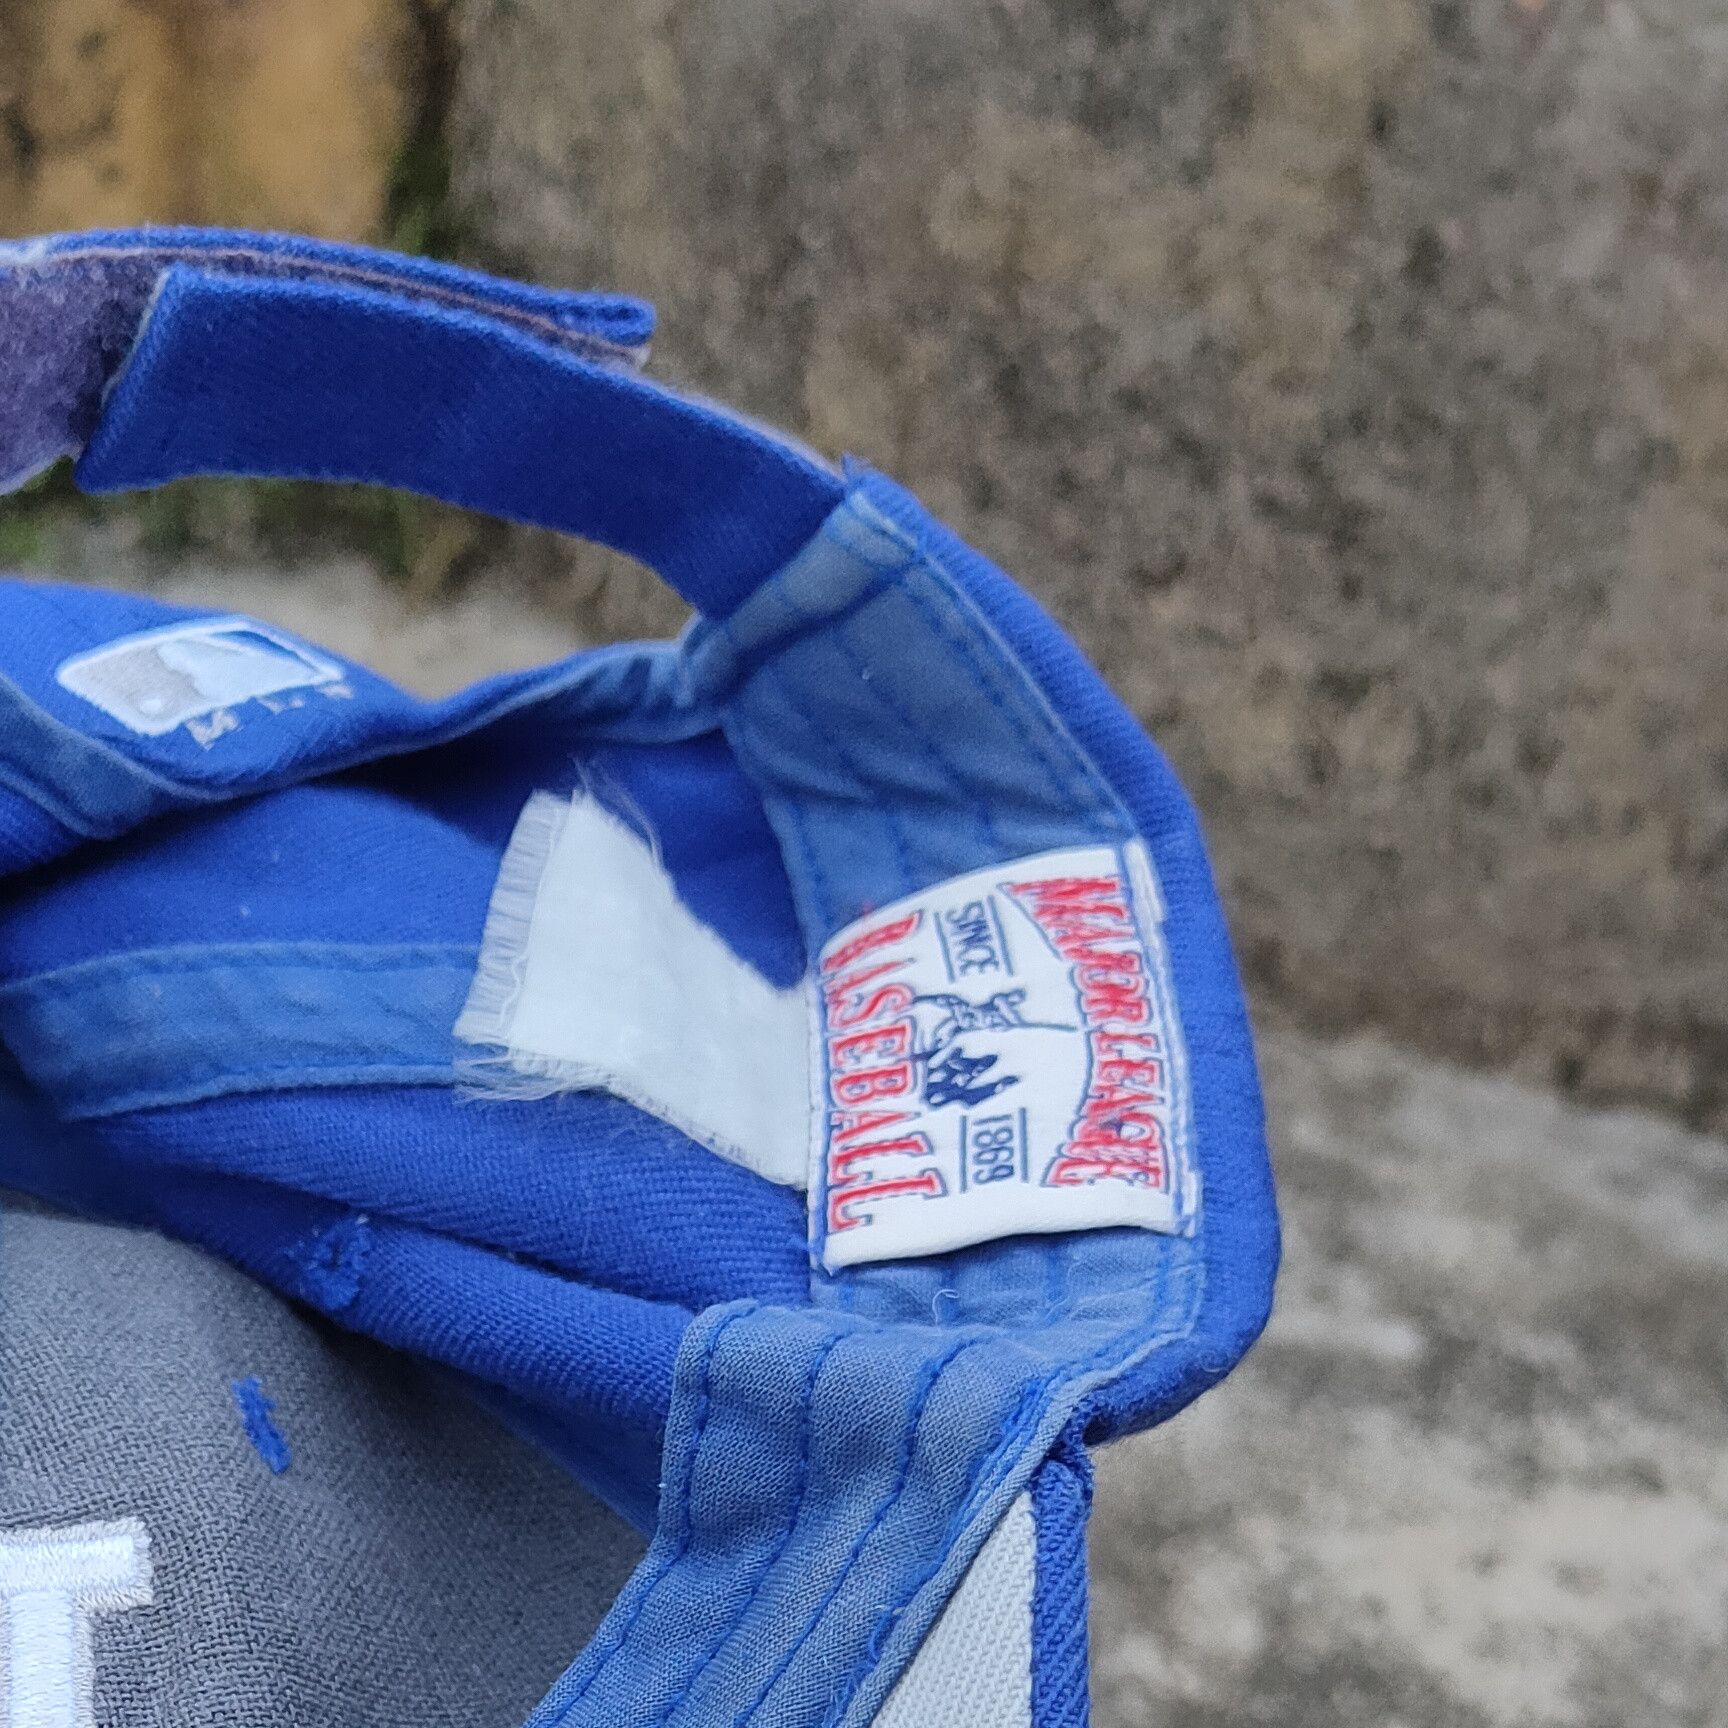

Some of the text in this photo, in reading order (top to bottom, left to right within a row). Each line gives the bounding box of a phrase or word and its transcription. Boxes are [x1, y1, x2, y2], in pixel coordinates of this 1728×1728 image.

[822, 909, 949, 1232] BASEBALL
[945, 901, 1016, 1185] SINCE 1869
[999, 875, 1170, 1194] MAJOR LEAGUE
